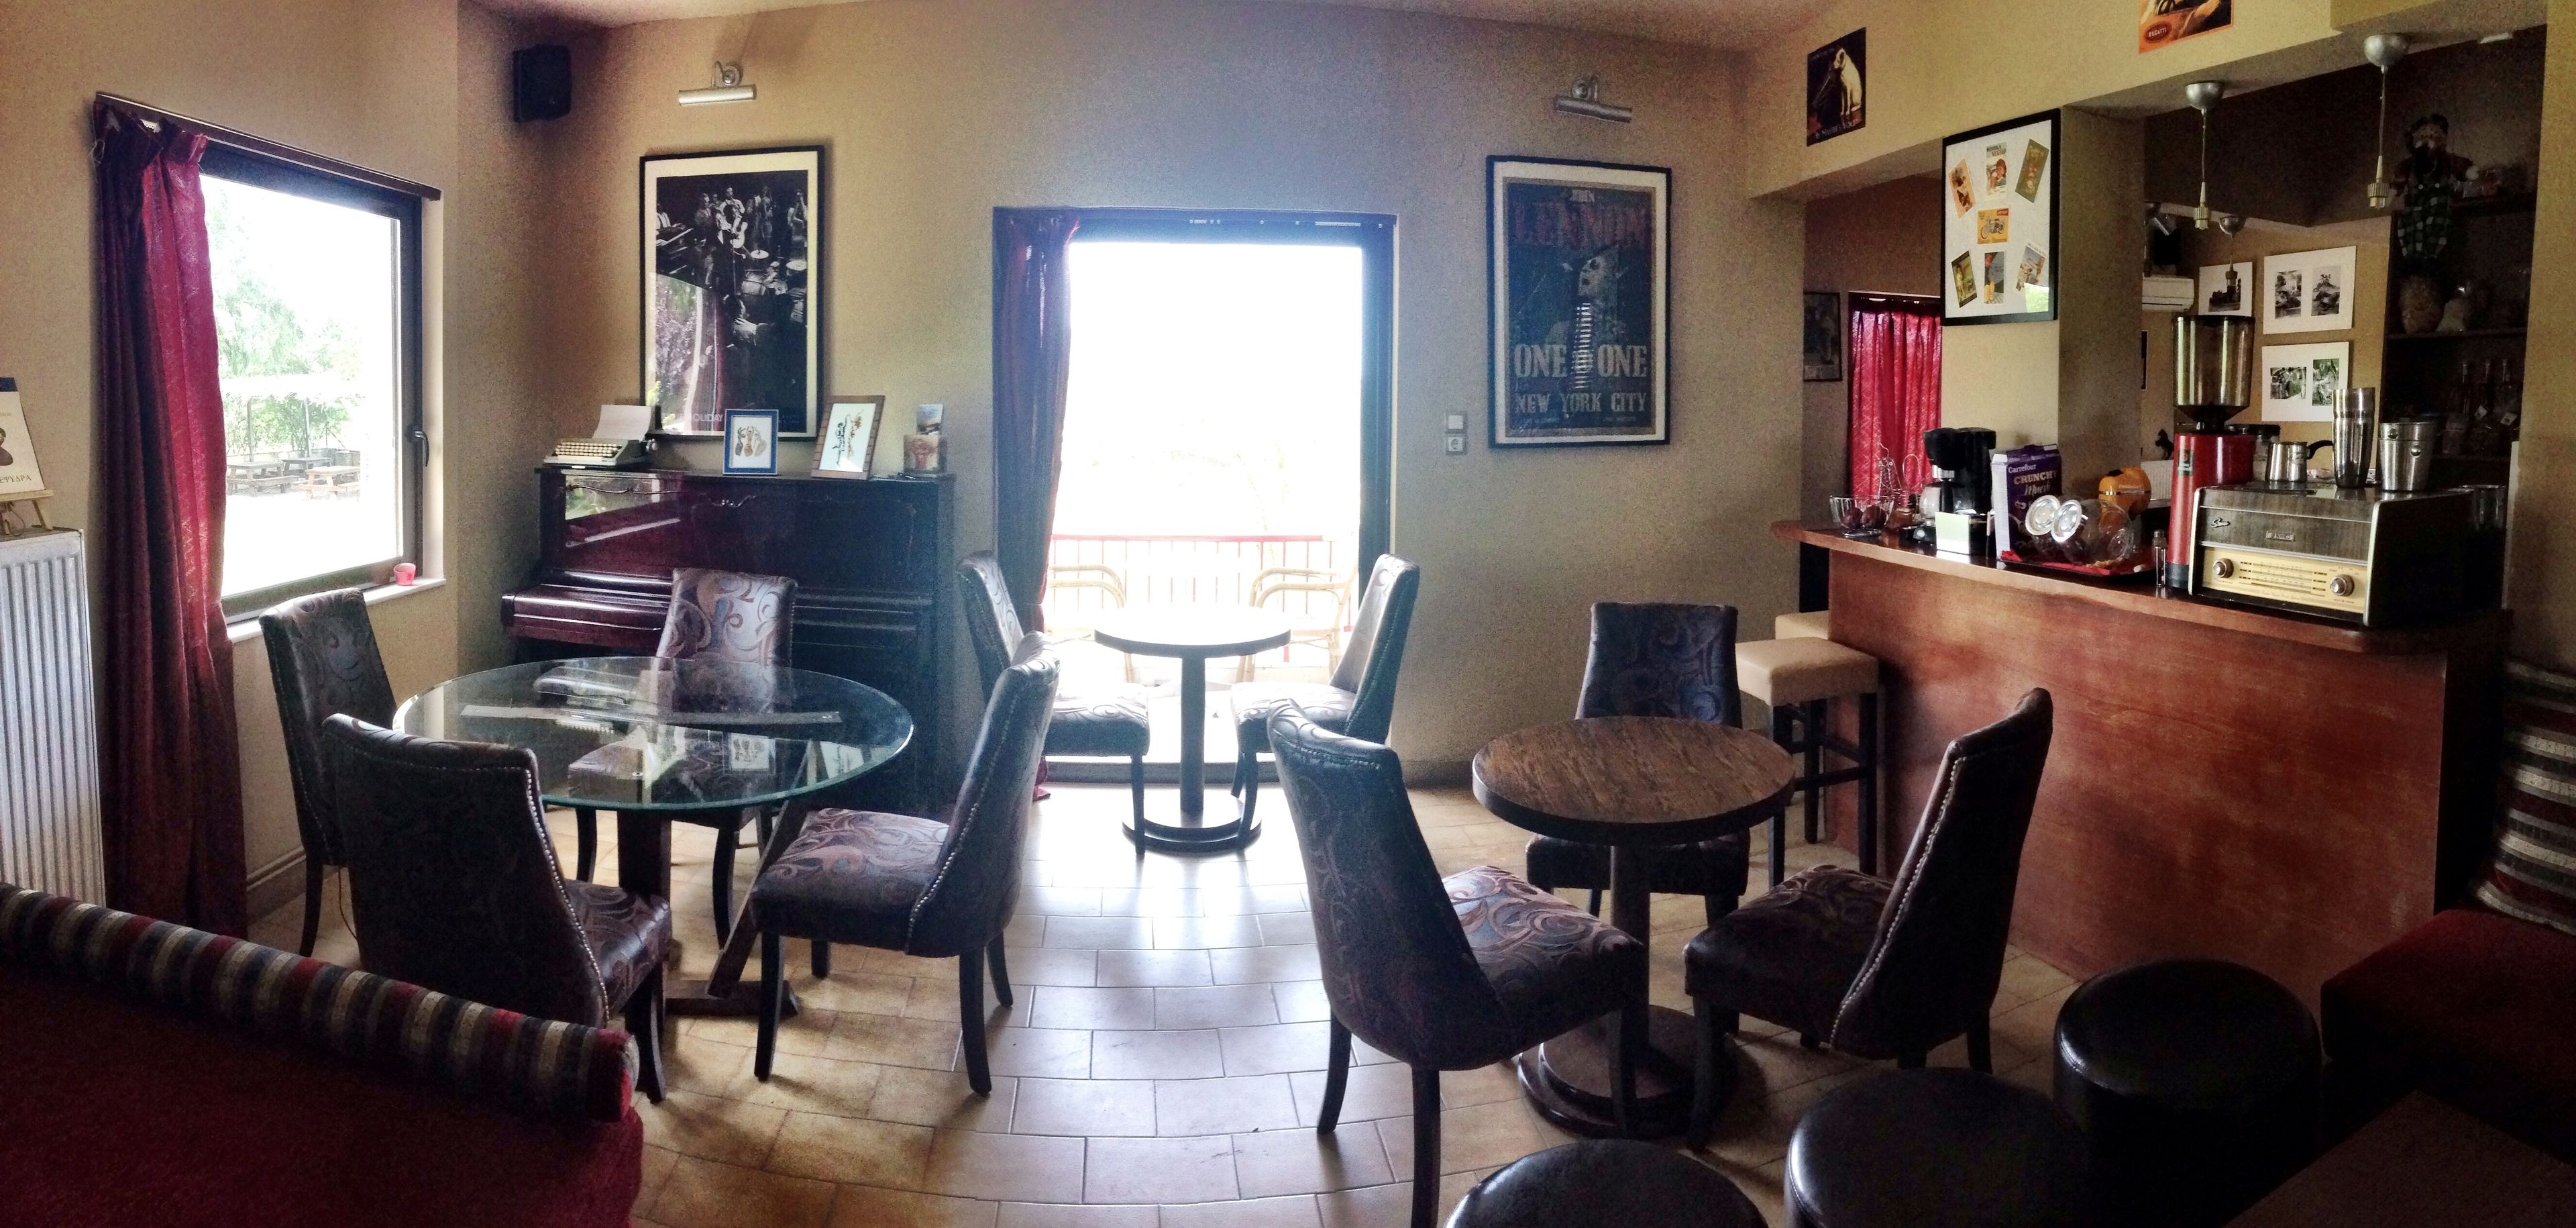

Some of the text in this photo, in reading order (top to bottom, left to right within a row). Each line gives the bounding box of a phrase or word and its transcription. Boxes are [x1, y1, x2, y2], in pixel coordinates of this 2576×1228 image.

[2149, 28, 2167, 38] BUGATTI
[1515, 201, 1649, 248] LENNON
[1513, 343, 1567, 378] ONE
[1597, 344, 1647, 378] ONE
[1515, 393, 1647, 413] NEW YORK CITY
[688, 413, 723, 422] OLIDAY
[2008, 464, 2037, 473] Carrefour
[2014, 470, 2057, 484] CRUNCHY
